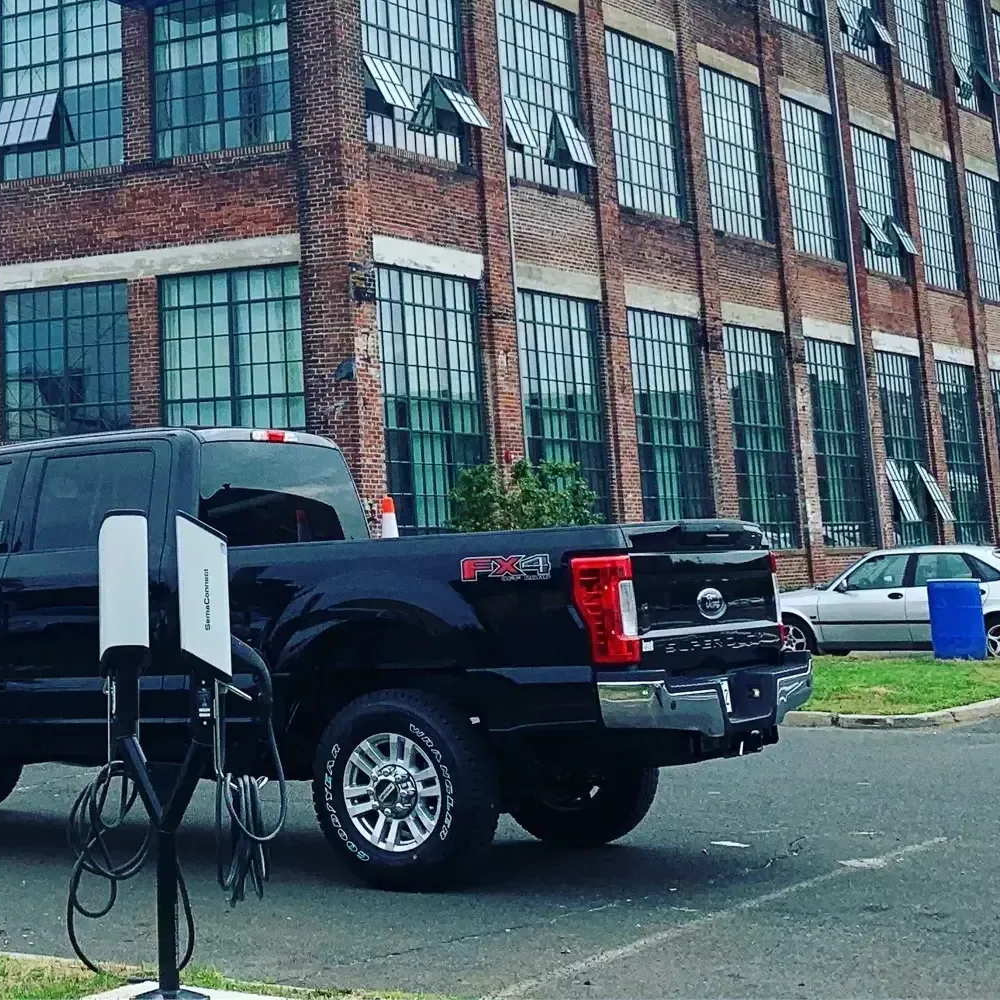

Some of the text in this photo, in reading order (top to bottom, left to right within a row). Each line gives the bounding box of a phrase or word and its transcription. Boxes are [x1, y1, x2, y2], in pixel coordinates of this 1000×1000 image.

[203, 568, 212, 631] SemaConnect
[460, 553, 552, 582] FX4
[324, 743, 370, 862] GOODYEAR
[408, 722, 455, 842] WRANGLER
